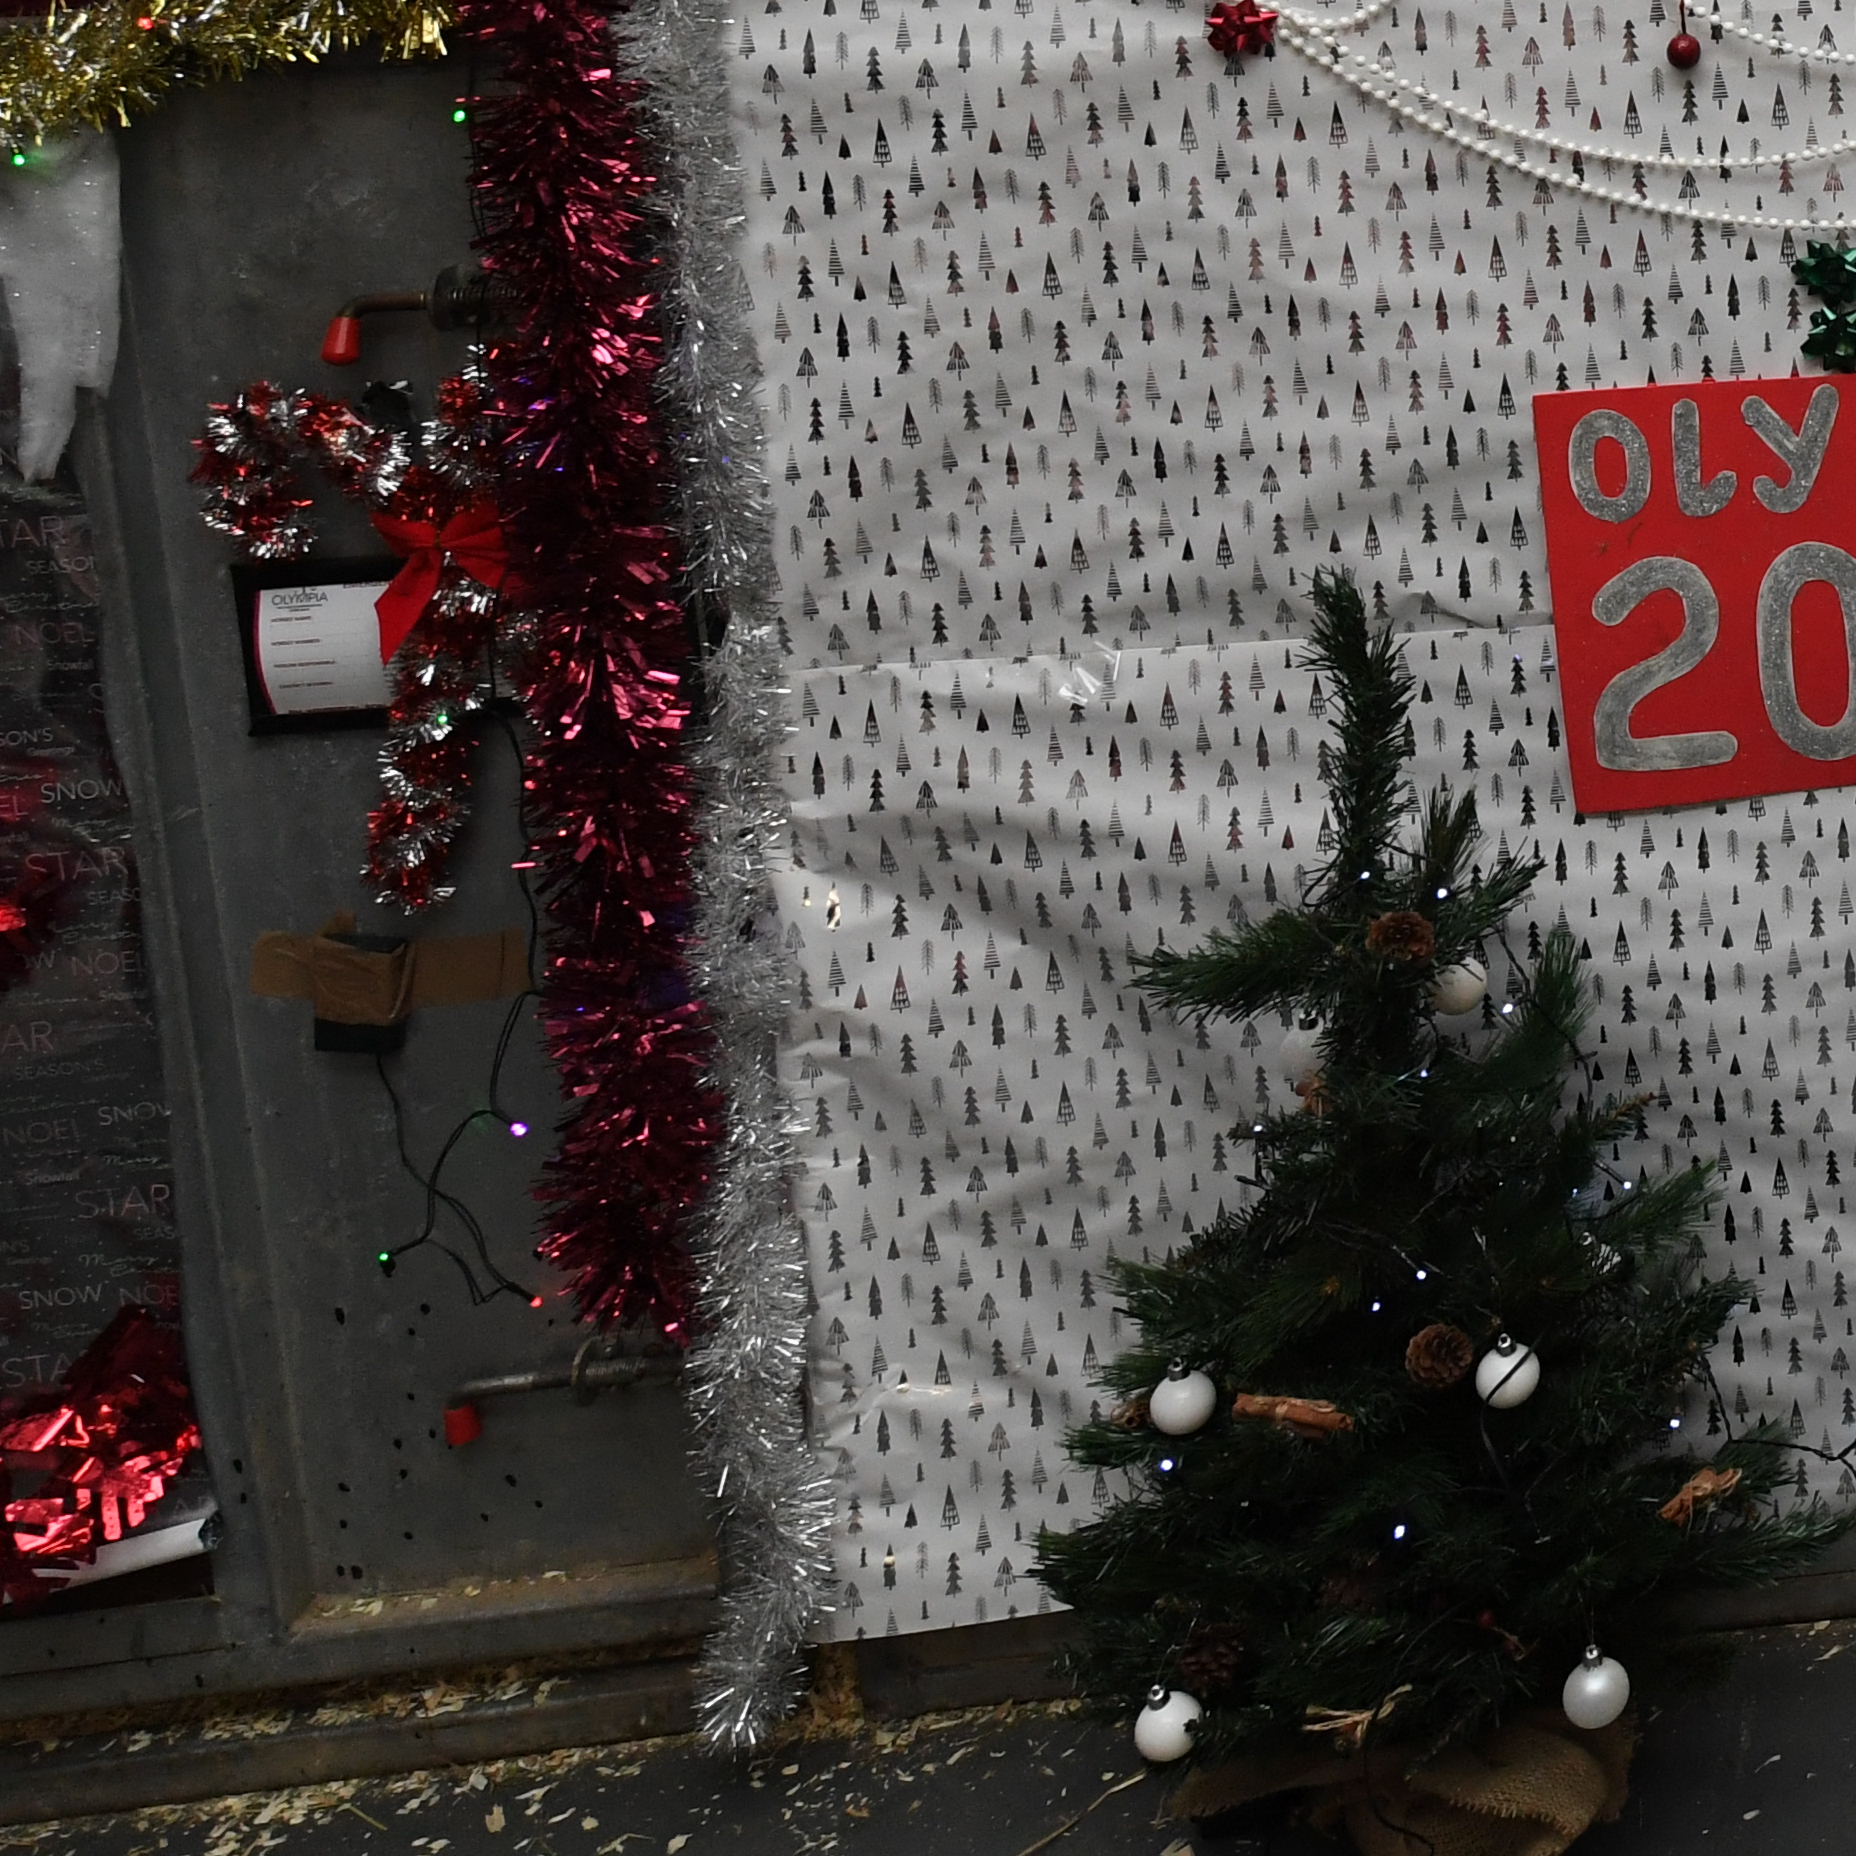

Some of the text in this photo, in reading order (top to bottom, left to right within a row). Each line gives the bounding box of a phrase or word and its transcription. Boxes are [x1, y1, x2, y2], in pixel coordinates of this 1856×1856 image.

[271, 591, 329, 606] OLYMPIA
[40, 779, 122, 804] SNOW
[25, 846, 129, 882] STAR
[75, 1183, 171, 1220] STAR
[19, 1284, 103, 1310] SNOW
